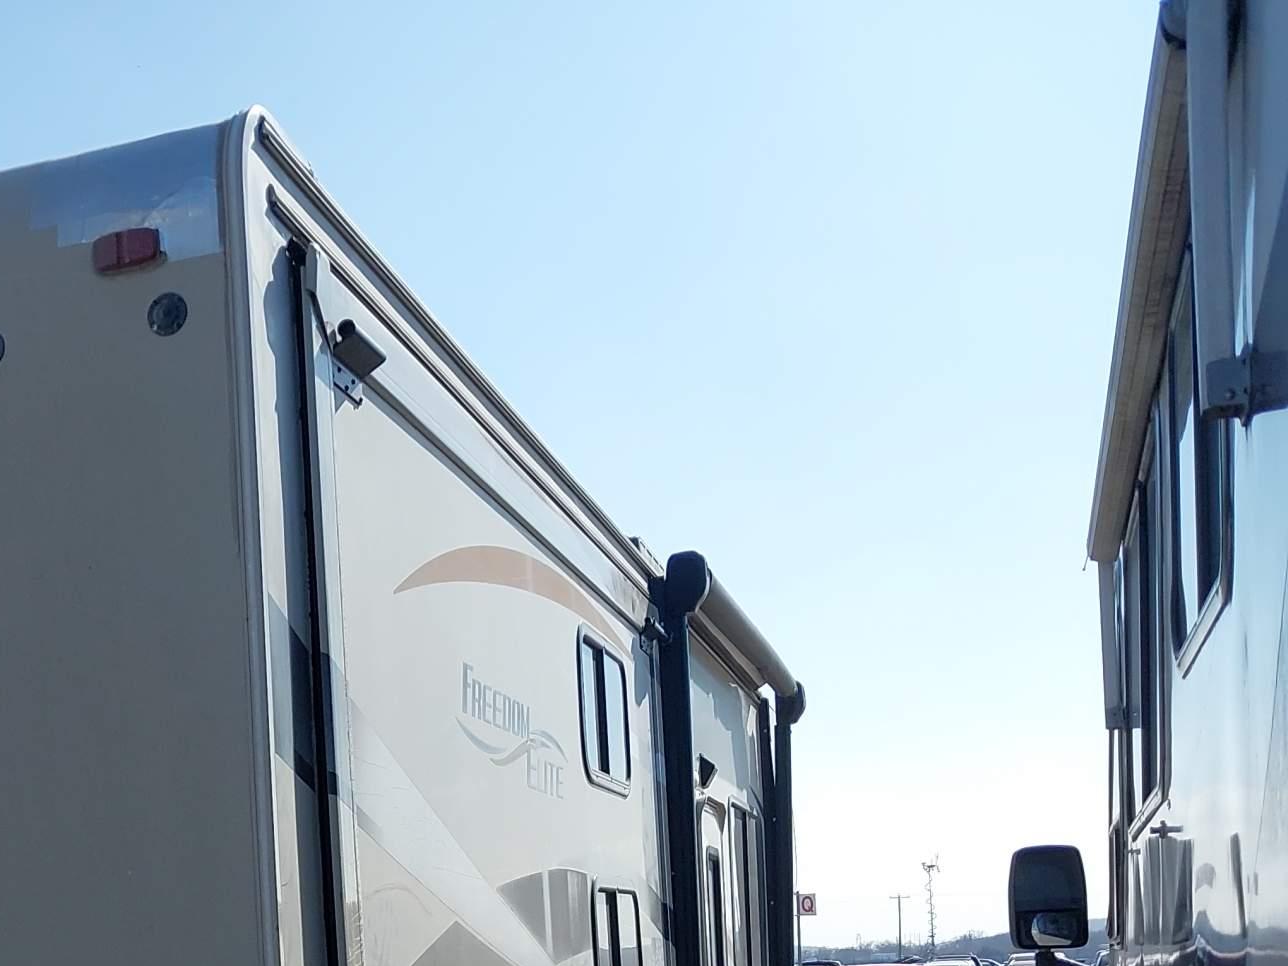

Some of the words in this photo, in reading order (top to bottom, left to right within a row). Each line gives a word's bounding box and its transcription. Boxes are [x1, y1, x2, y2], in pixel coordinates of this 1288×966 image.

[462, 661, 530, 740] FREEDOM
[526, 746, 564, 800] ELITE
[801, 895, 814, 913] Q
